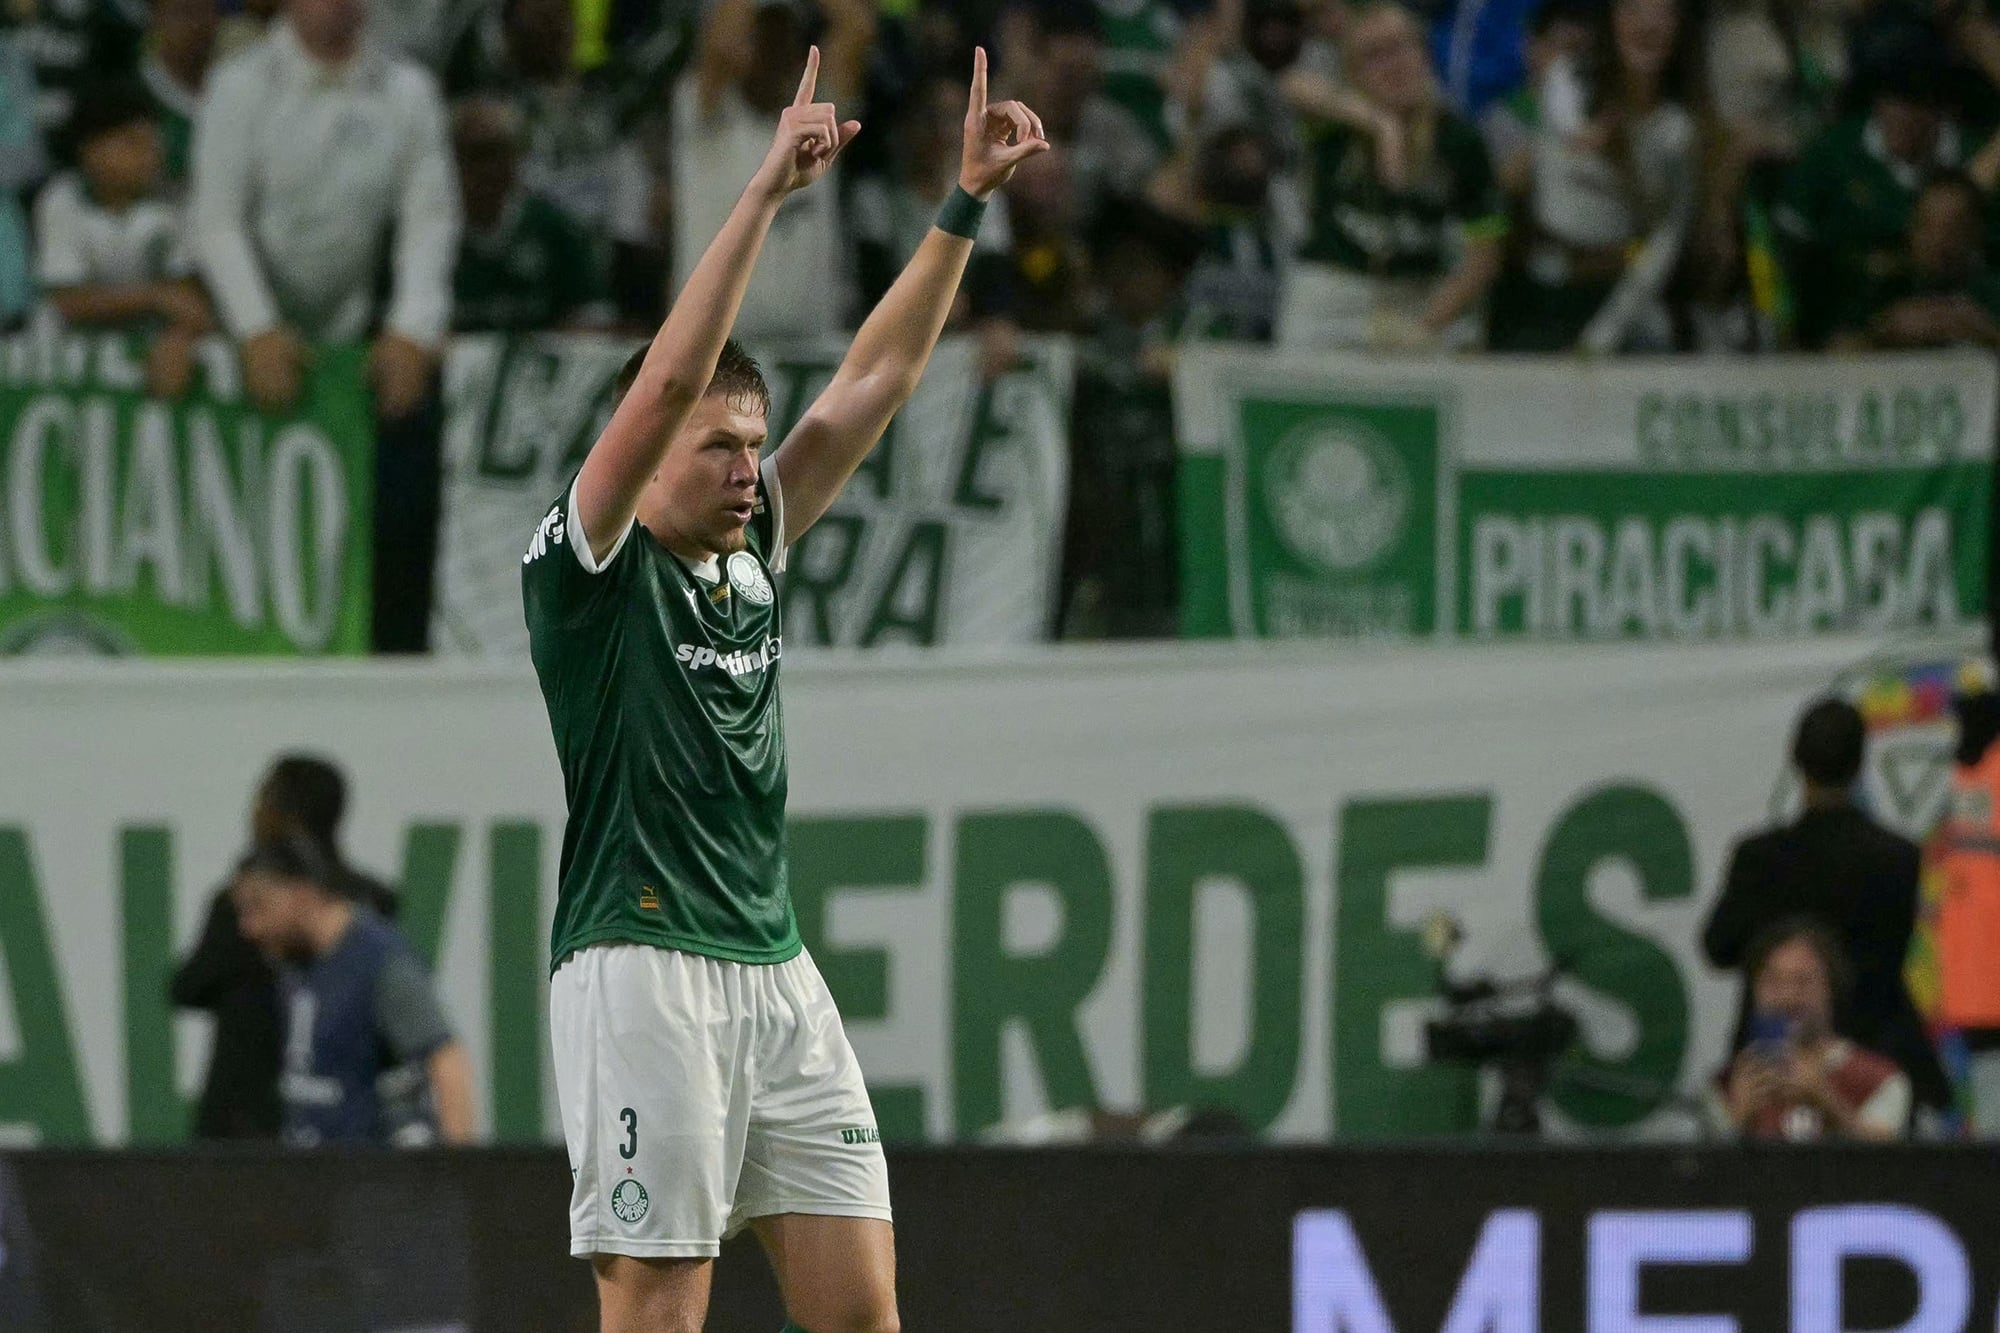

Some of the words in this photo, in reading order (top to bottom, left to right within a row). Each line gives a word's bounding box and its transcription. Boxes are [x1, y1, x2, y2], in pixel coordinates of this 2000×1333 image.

[0, 393, 348, 653] CIANO
[619, 1107, 637, 1160] 3
[613, 1197, 648, 1221] PALMEIRAS
